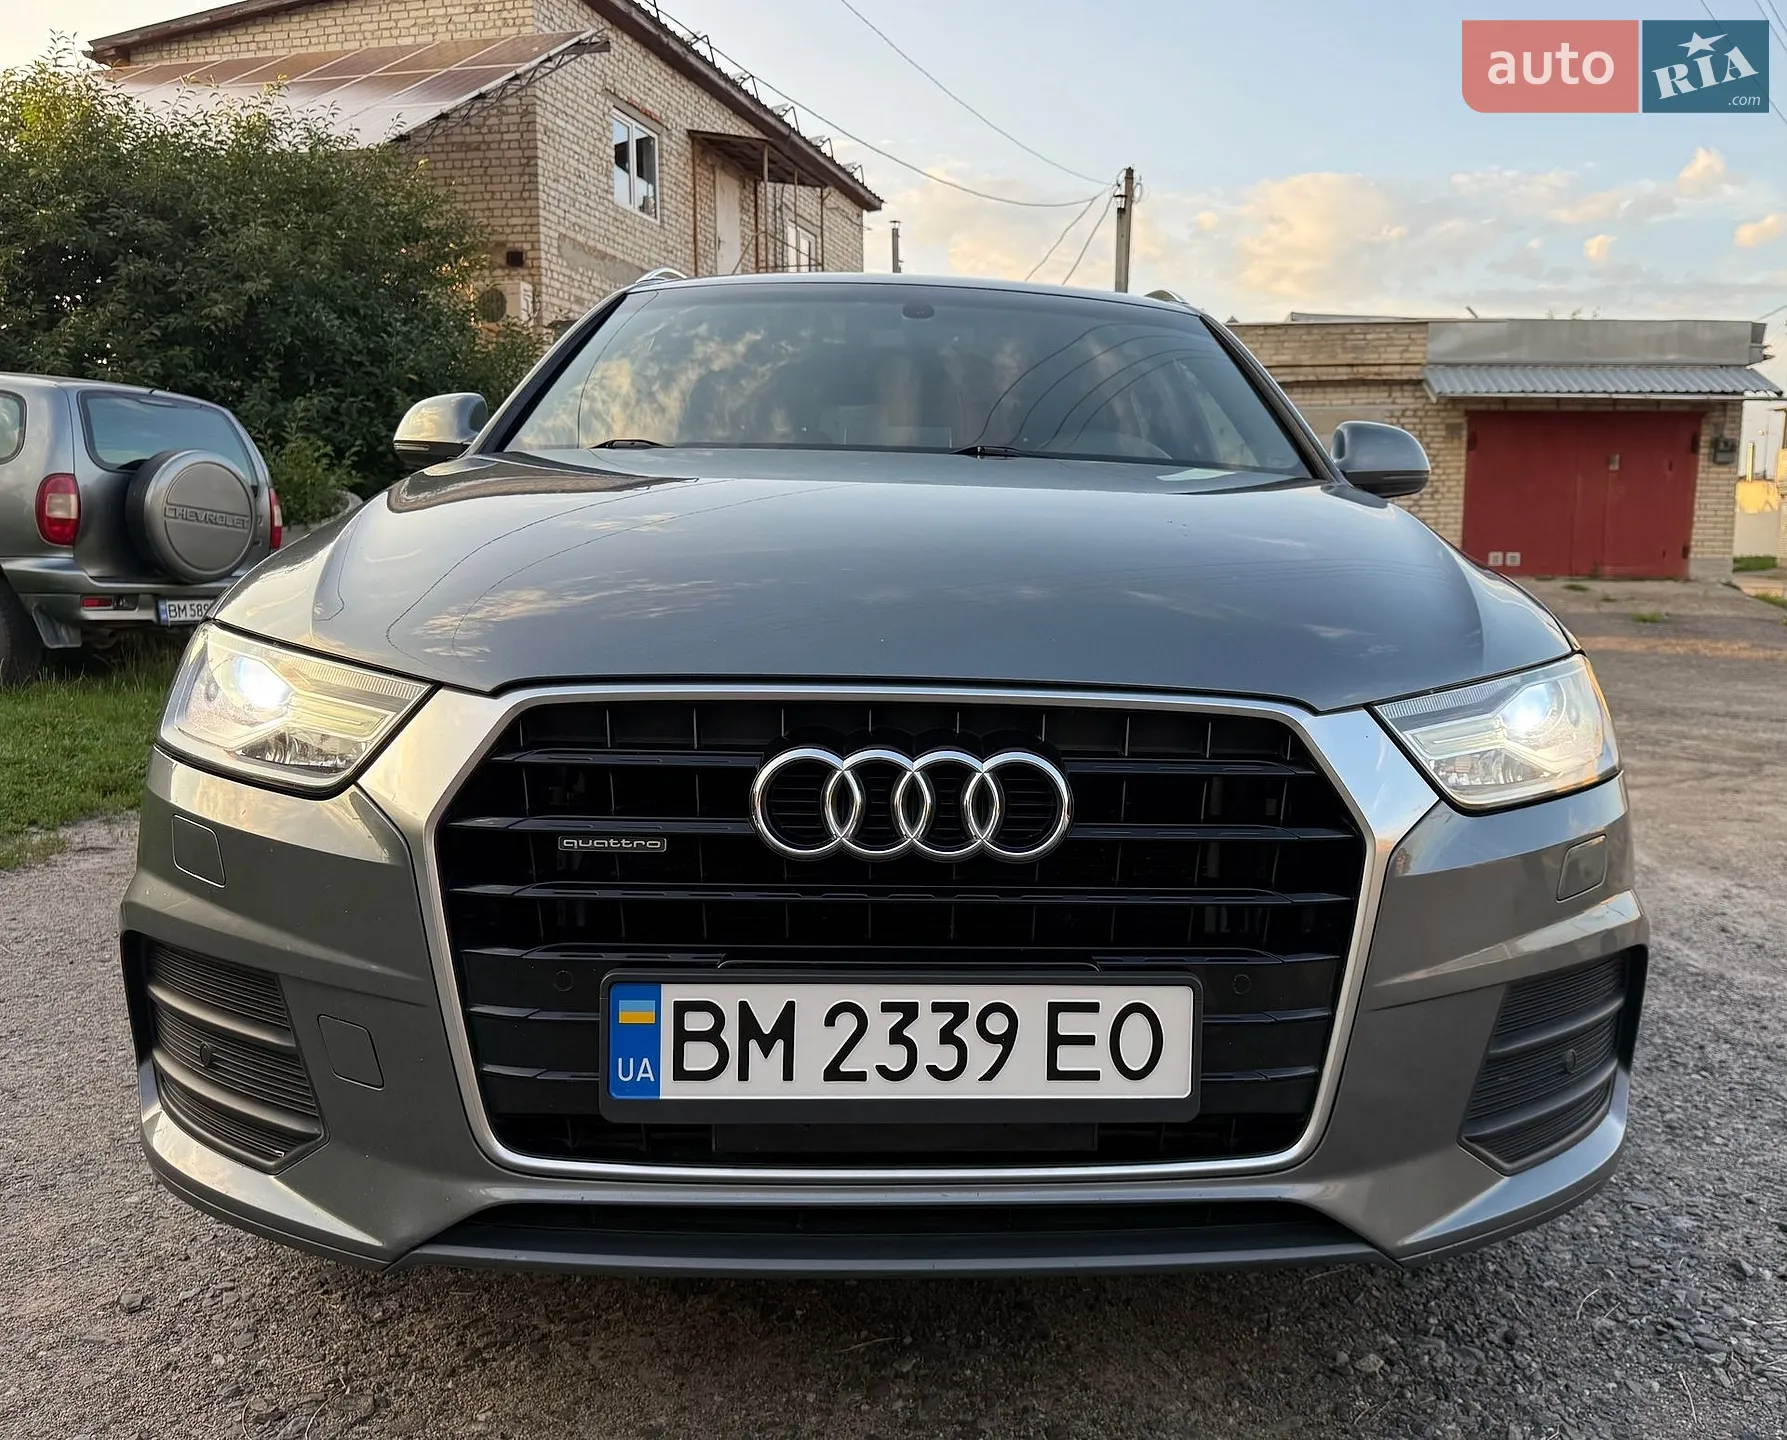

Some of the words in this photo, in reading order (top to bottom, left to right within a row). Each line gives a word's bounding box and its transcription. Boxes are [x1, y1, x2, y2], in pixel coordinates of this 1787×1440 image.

[165, 505, 250, 530] CHEVROLET
[168, 603, 188, 619] BM
[563, 839, 661, 849] quattro
[671, 999, 797, 1082] BM
[821, 1000, 1020, 1082] 2339
[1046, 1000, 1165, 1082] EO
[617, 1057, 655, 1082] UA
